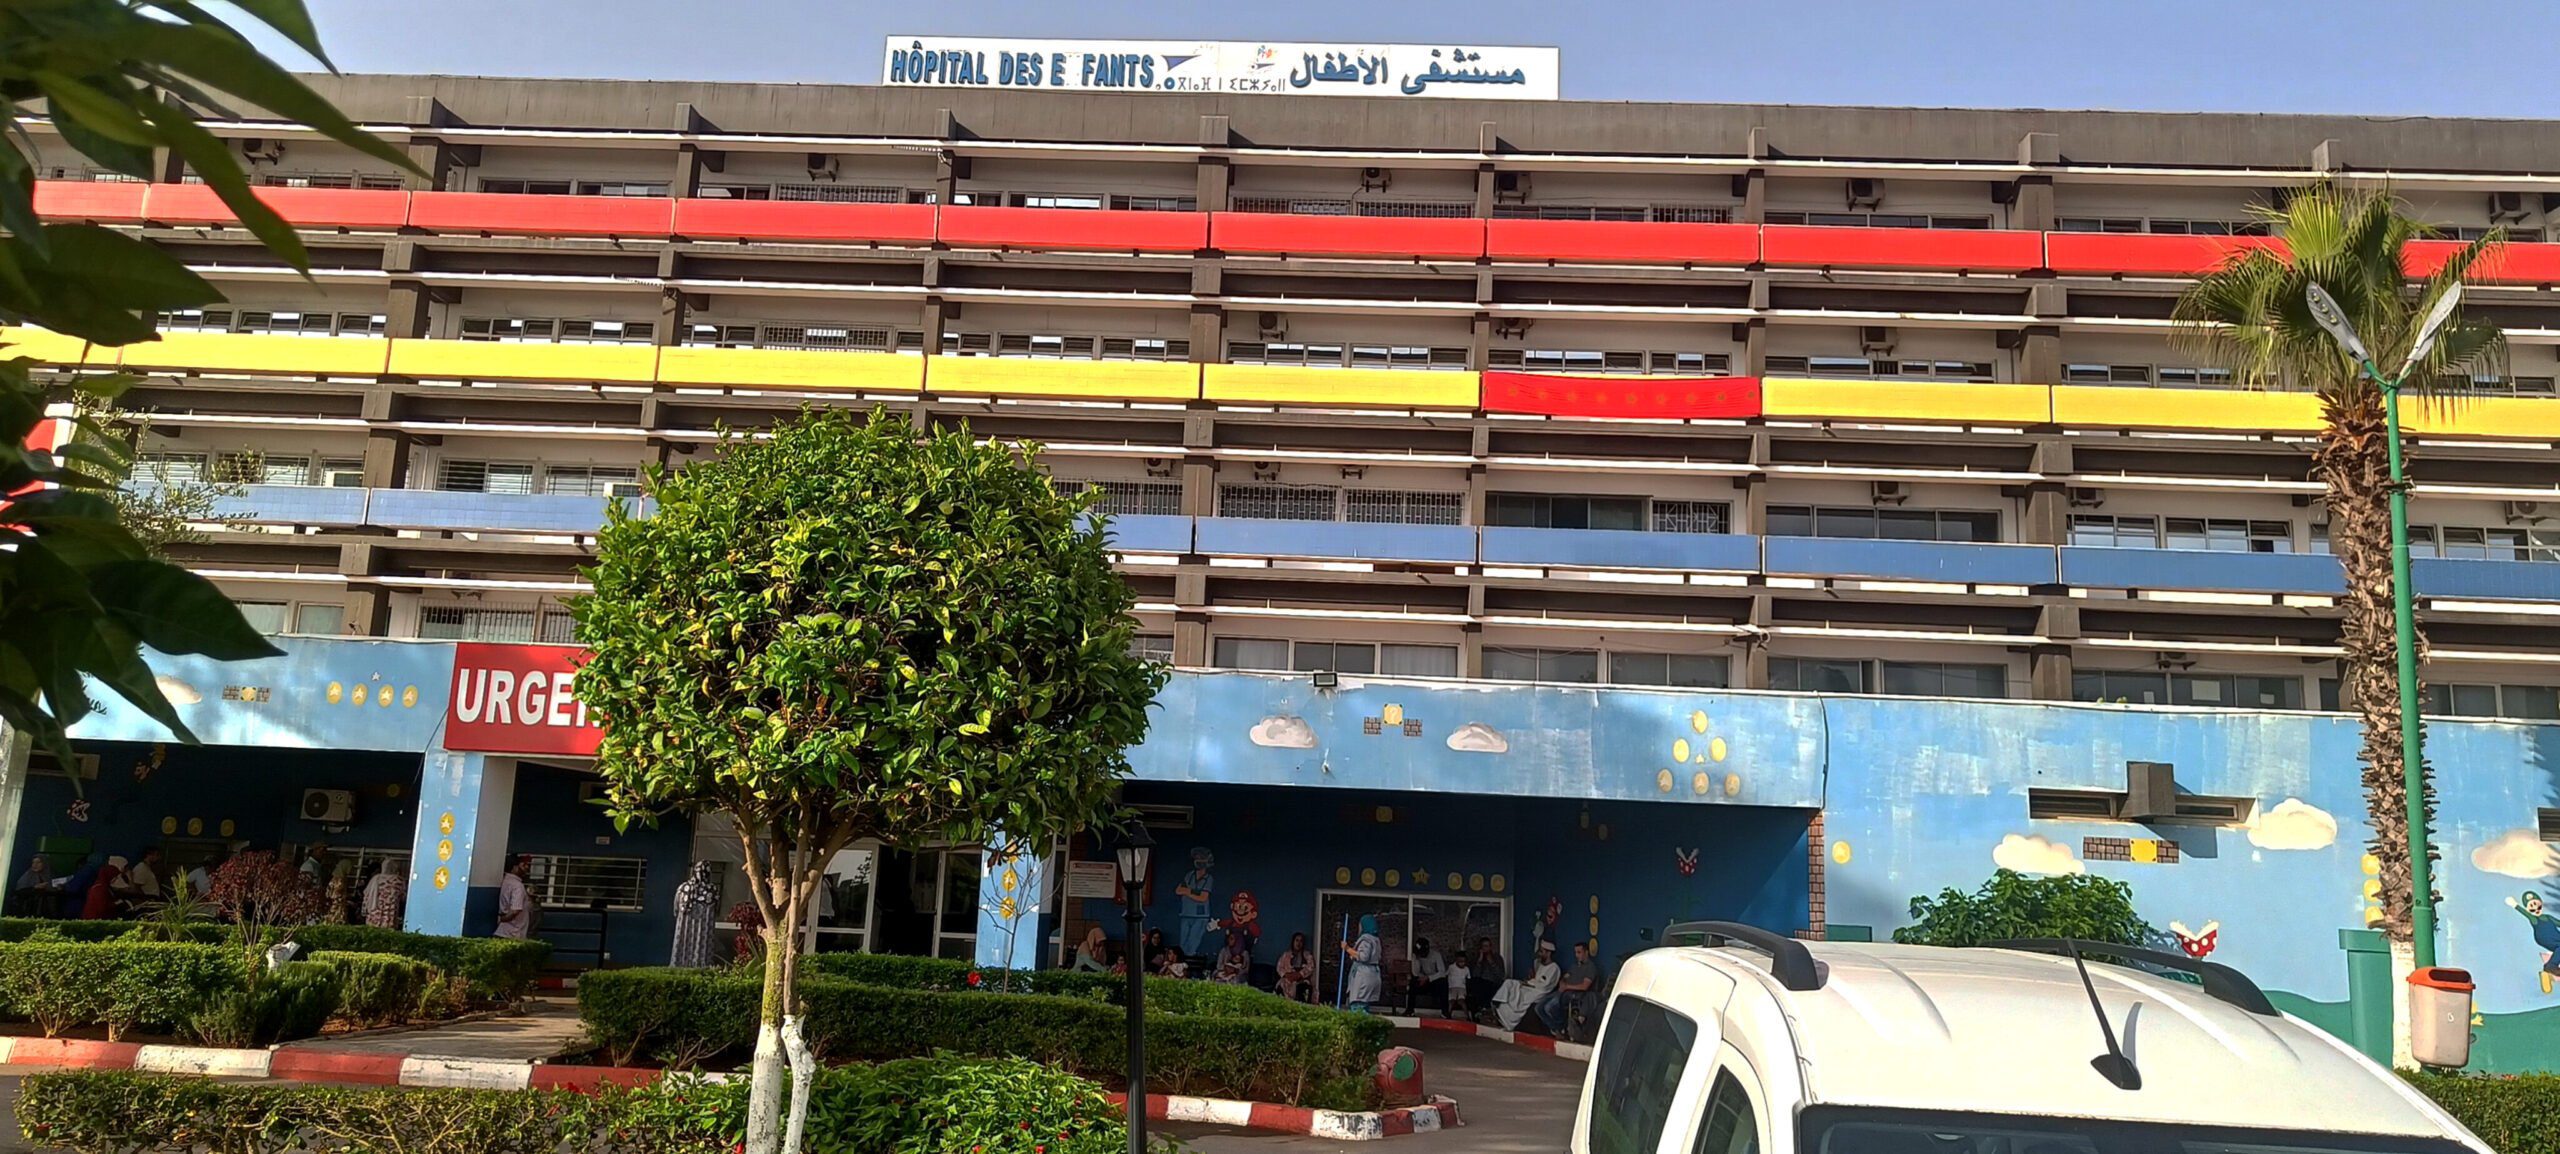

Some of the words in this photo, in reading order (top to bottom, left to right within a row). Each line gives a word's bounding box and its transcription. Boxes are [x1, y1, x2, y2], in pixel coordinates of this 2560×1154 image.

[891, 40, 988, 85] HÔPITAL
[999, 51, 1043, 86] DES
[1401, 48, 1526, 95] مستشفى
